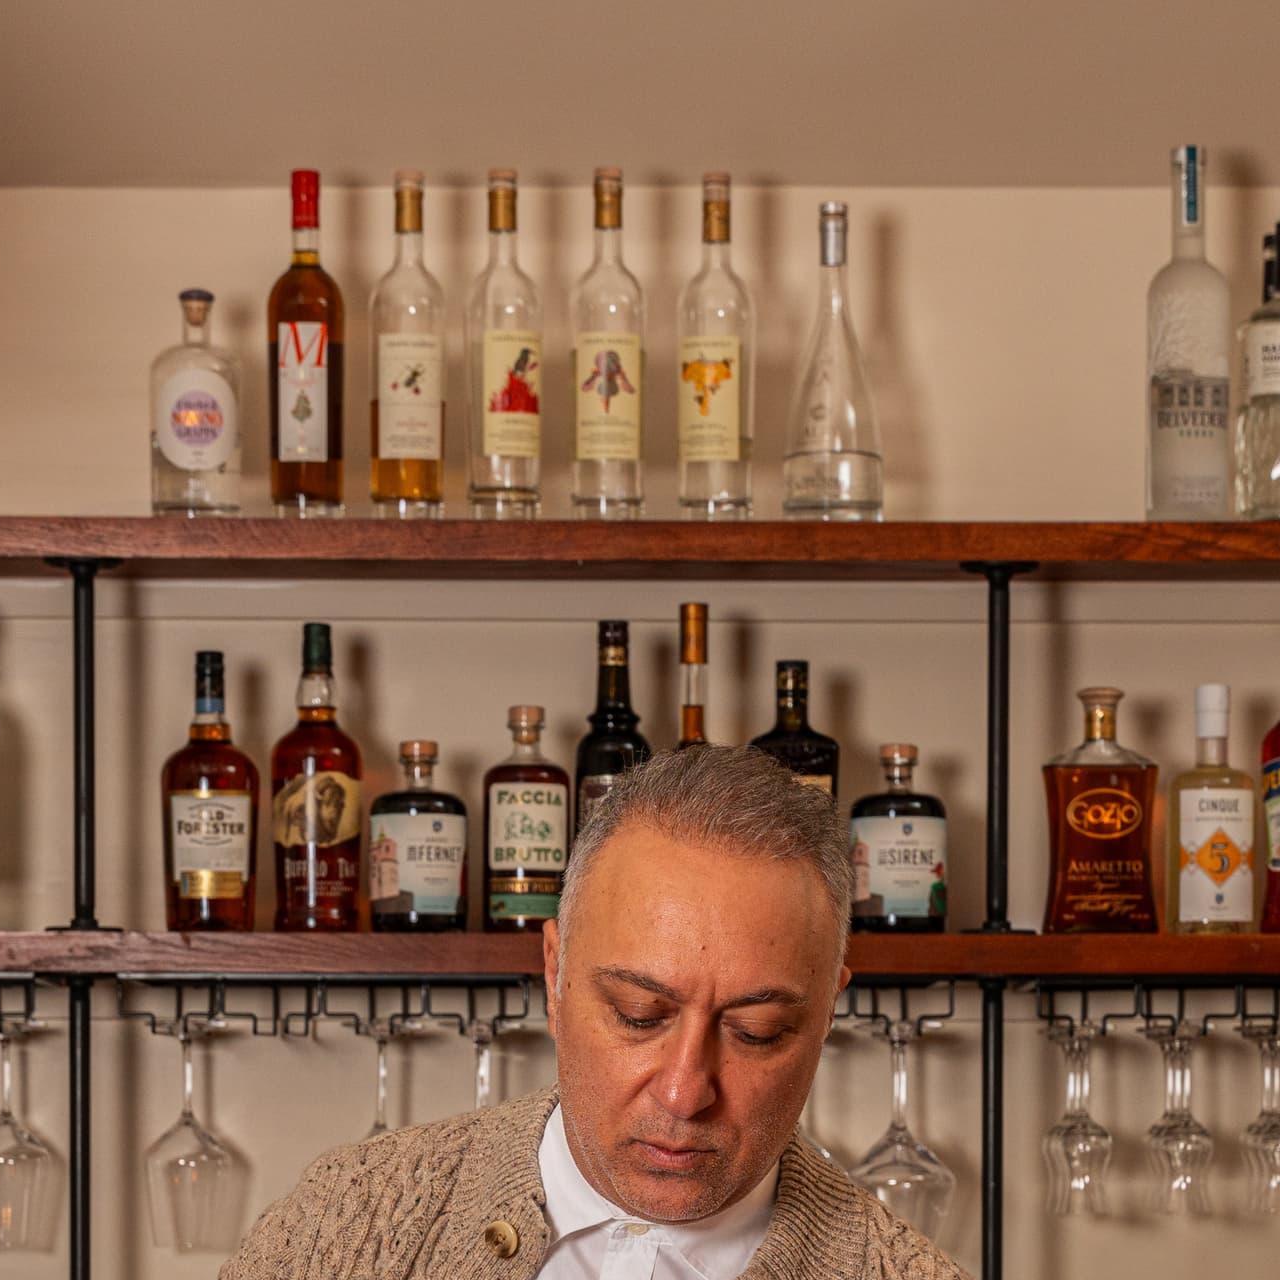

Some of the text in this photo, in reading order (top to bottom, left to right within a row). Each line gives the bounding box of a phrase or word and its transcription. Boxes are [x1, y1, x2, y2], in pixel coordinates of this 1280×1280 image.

[279, 322, 328, 368] M
[497, 790, 562, 806] FACCIA
[1198, 799, 1239, 813] CINQUE
[494, 847, 563, 862] BRUTTO
[887, 848, 934, 865] SIRENE
[285, 857, 328, 879] BUFFLO
[1067, 861, 1144, 873] AMARETTO
